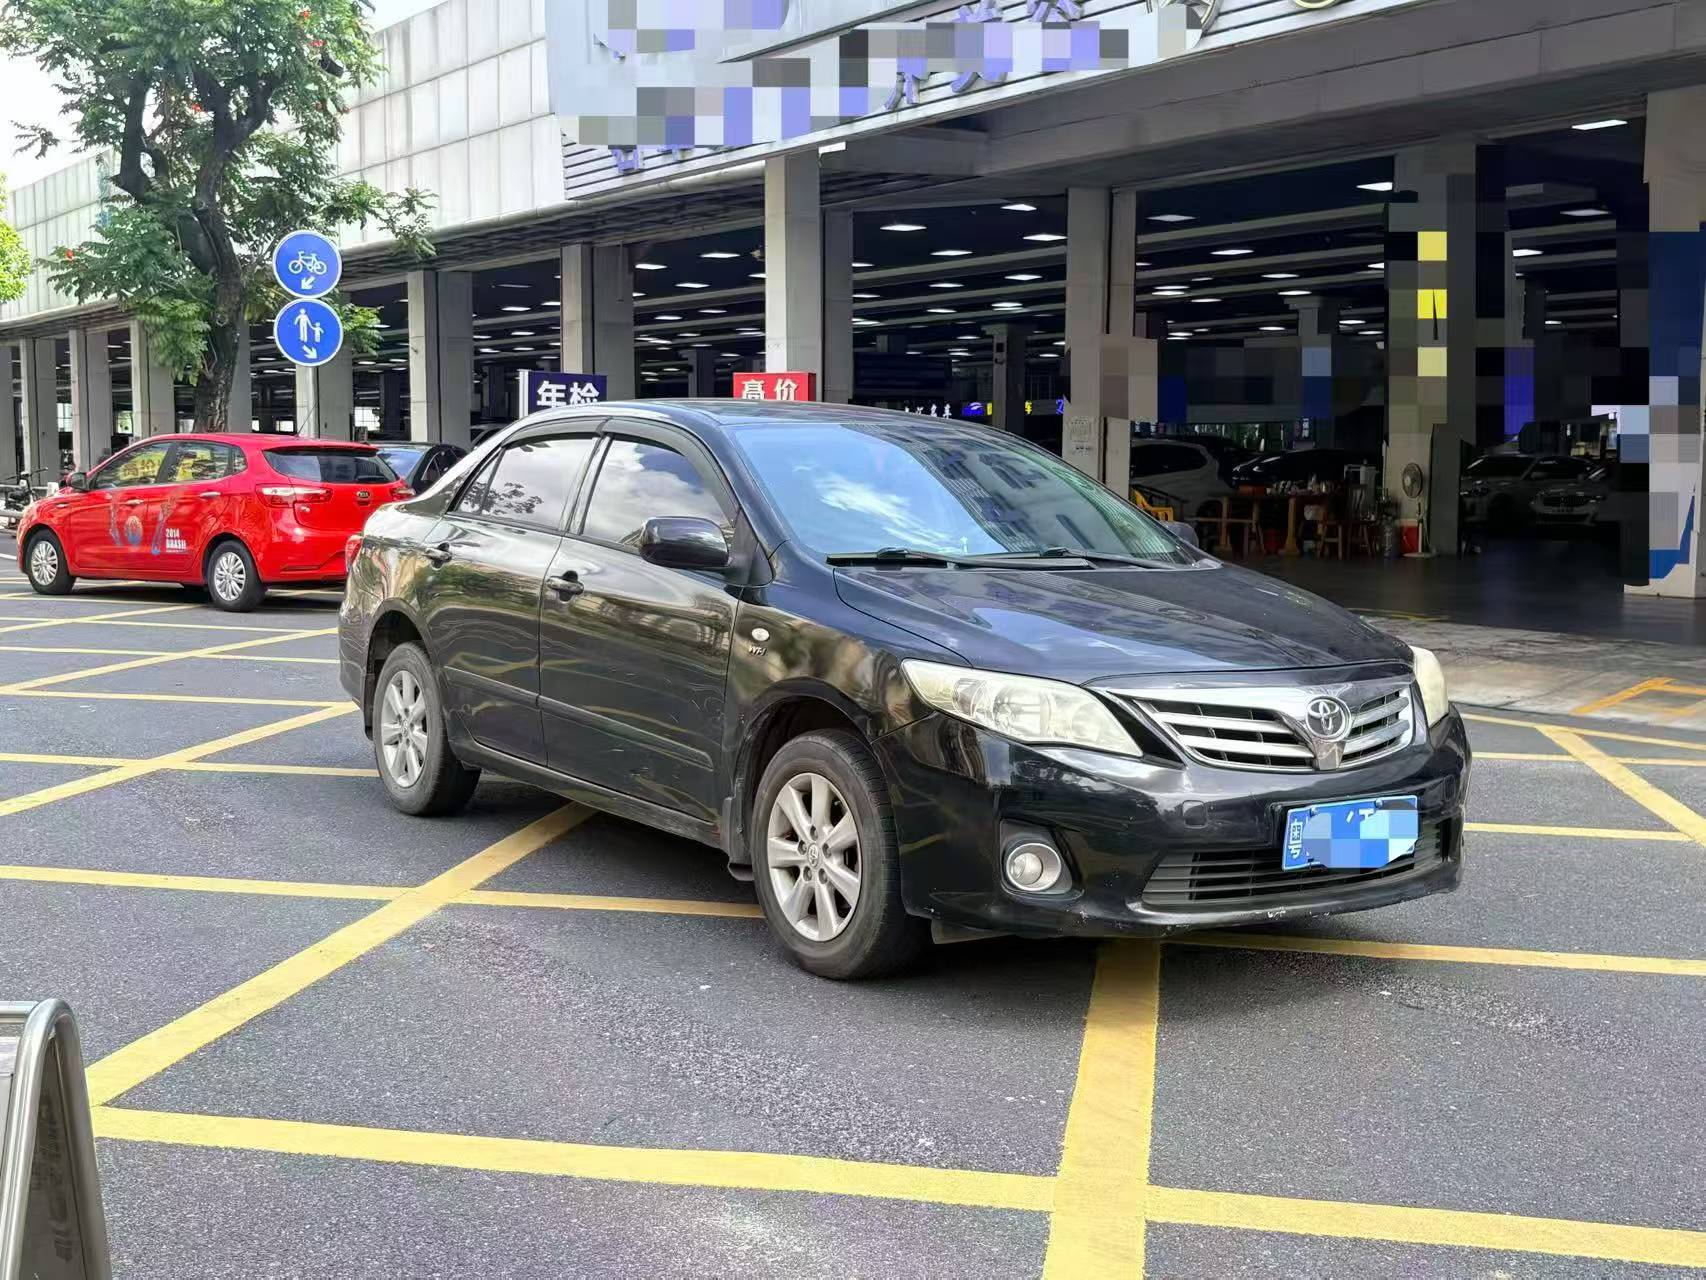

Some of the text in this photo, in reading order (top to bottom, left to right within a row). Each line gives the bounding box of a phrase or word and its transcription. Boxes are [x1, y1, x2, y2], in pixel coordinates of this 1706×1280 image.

[537, 380, 600, 407] 年检
[742, 379, 798, 400] 高价
[166, 528, 180, 538] 2014
